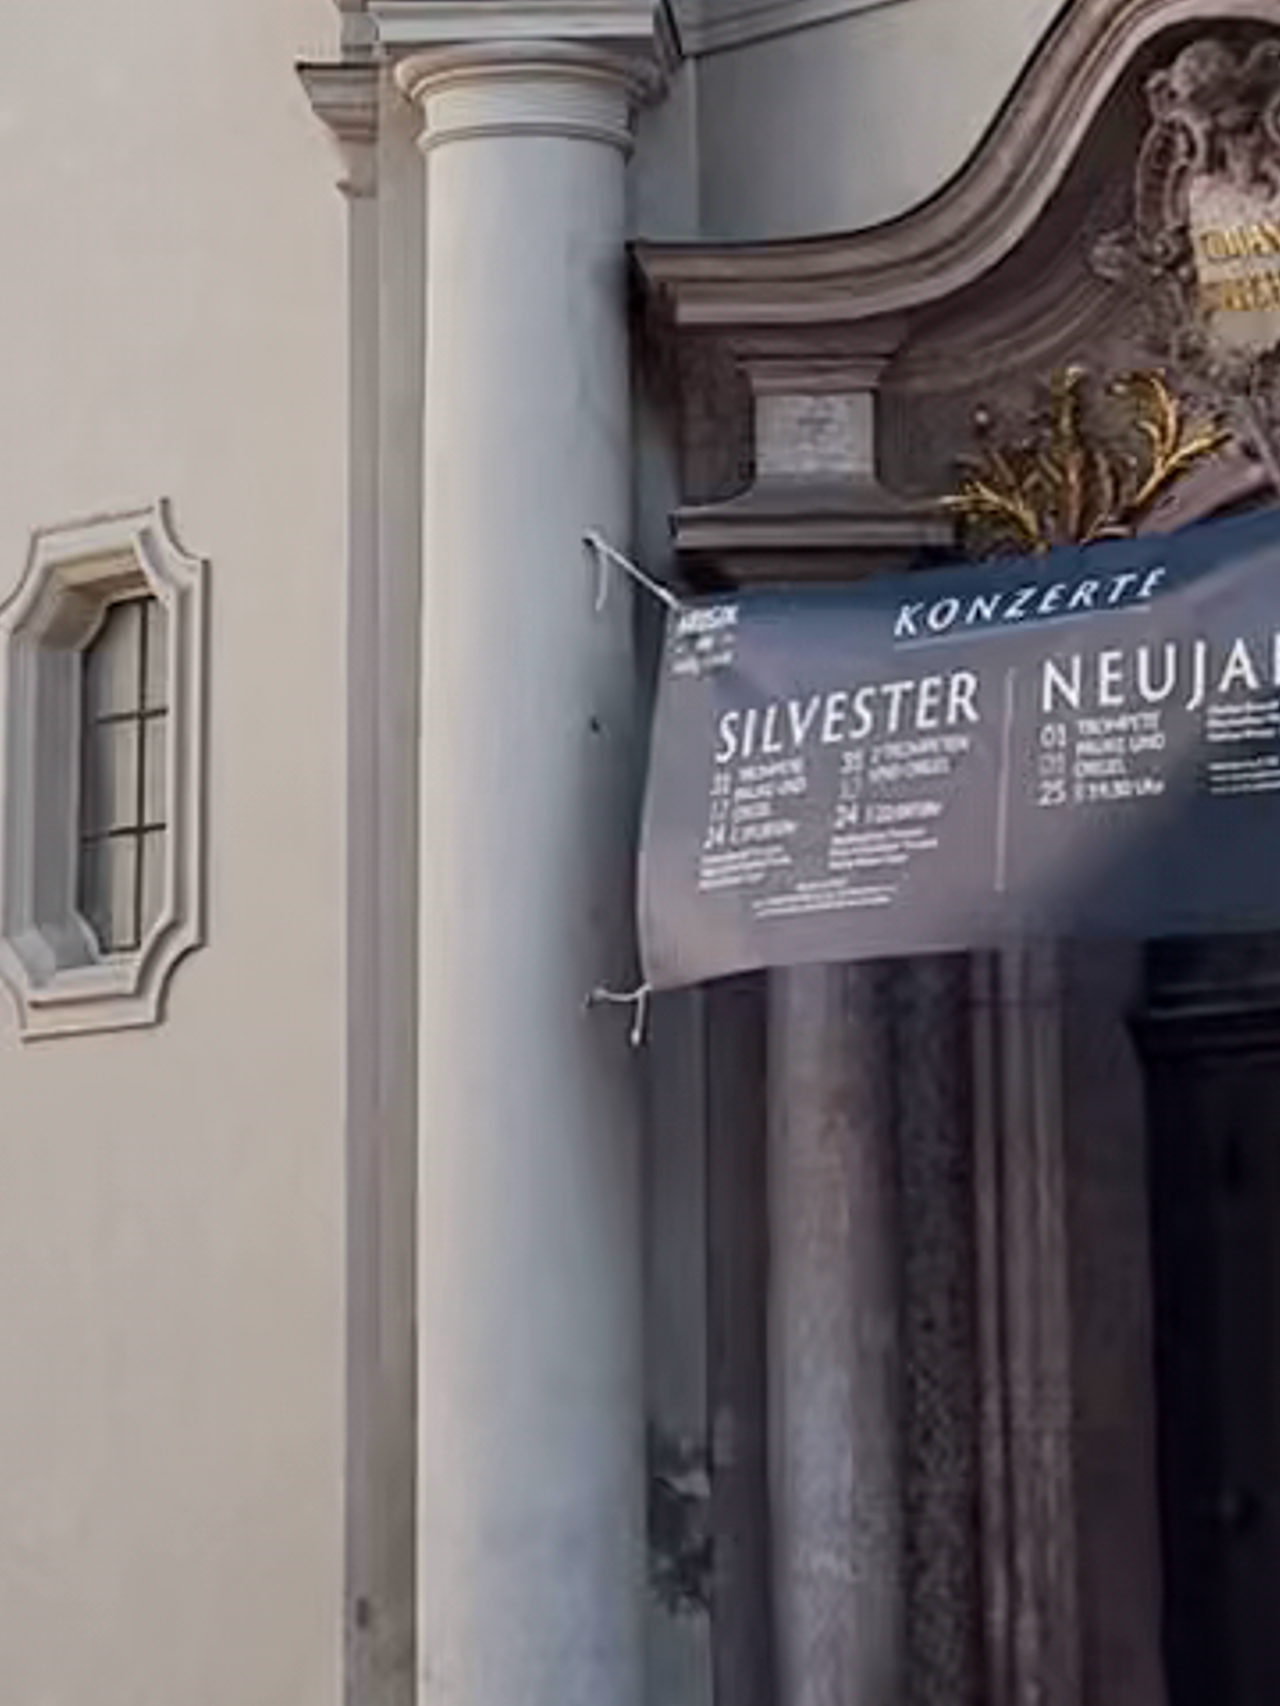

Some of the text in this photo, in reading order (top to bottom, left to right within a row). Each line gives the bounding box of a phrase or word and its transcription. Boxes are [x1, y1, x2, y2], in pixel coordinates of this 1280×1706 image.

[893, 566, 1166, 637] KONZERTE
[715, 671, 980, 764] SILVESTER
[1039, 722, 1067, 748] 01
[1037, 778, 1067, 807] 25
